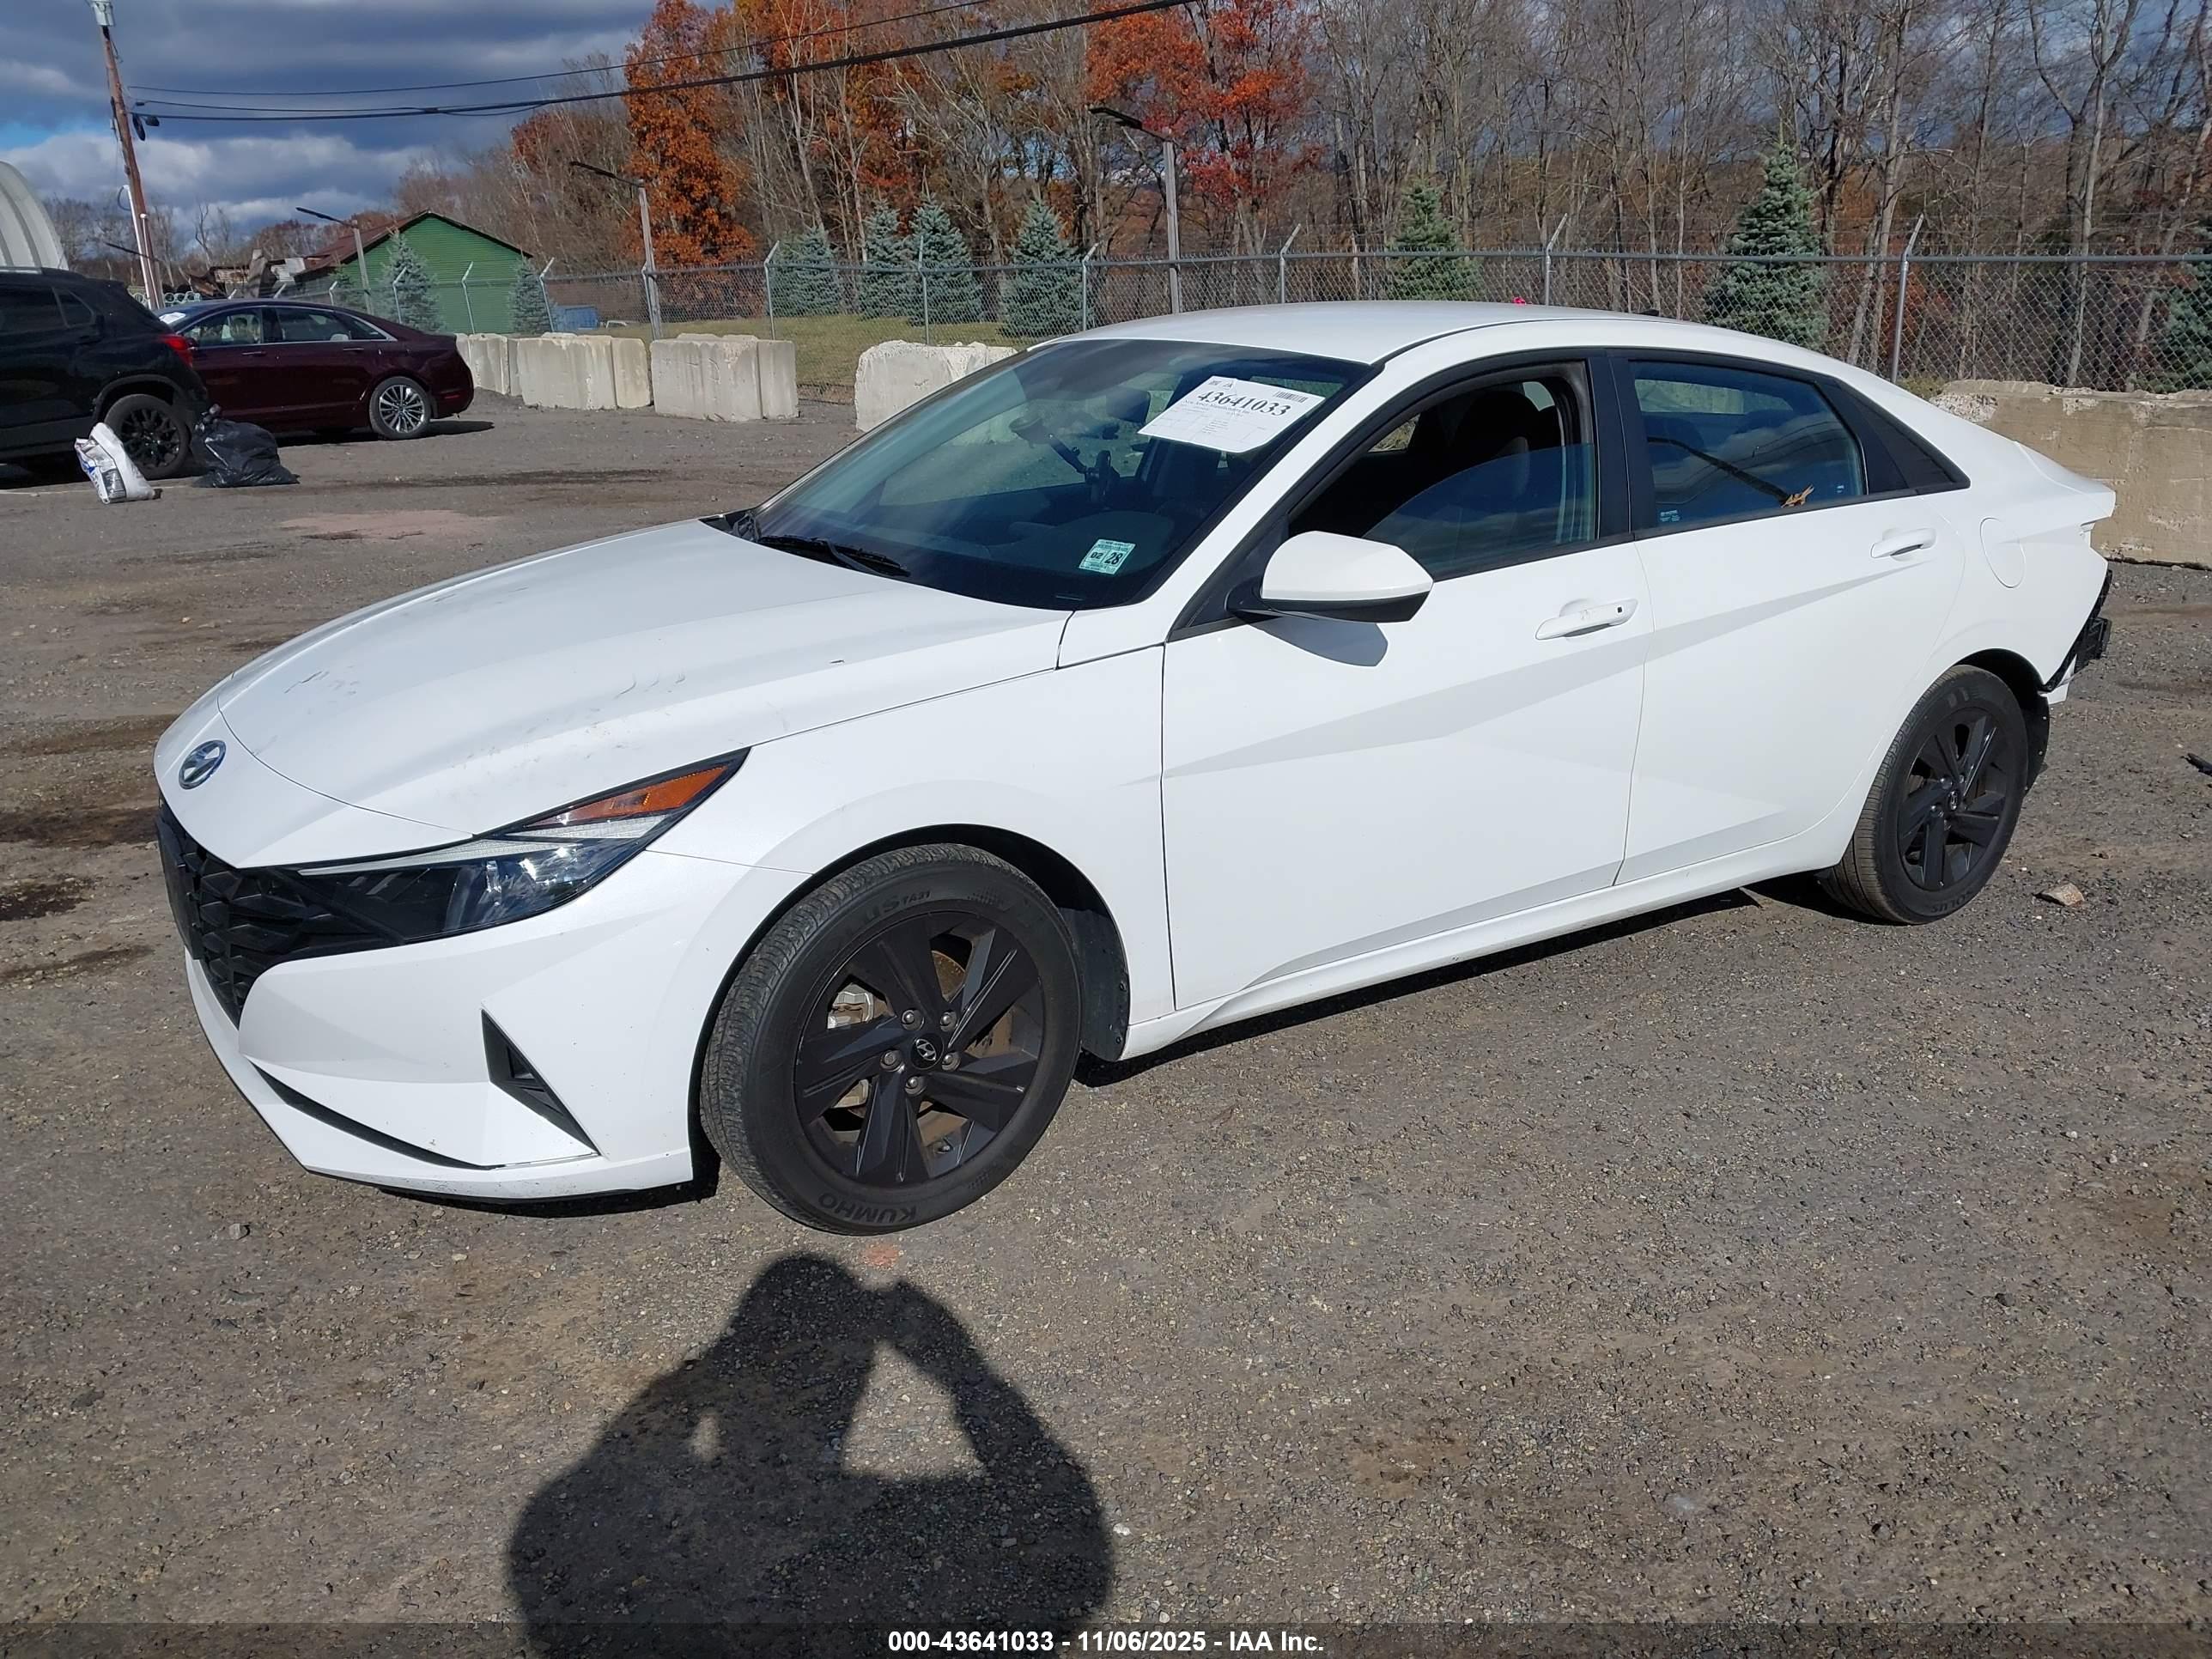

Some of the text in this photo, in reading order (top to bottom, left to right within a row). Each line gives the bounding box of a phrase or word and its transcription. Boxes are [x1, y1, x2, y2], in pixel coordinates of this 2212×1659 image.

[1197, 391, 1291, 416] 43641033
[1104, 552, 1123, 564] 28
[818, 1192, 917, 1224] KUMHO
